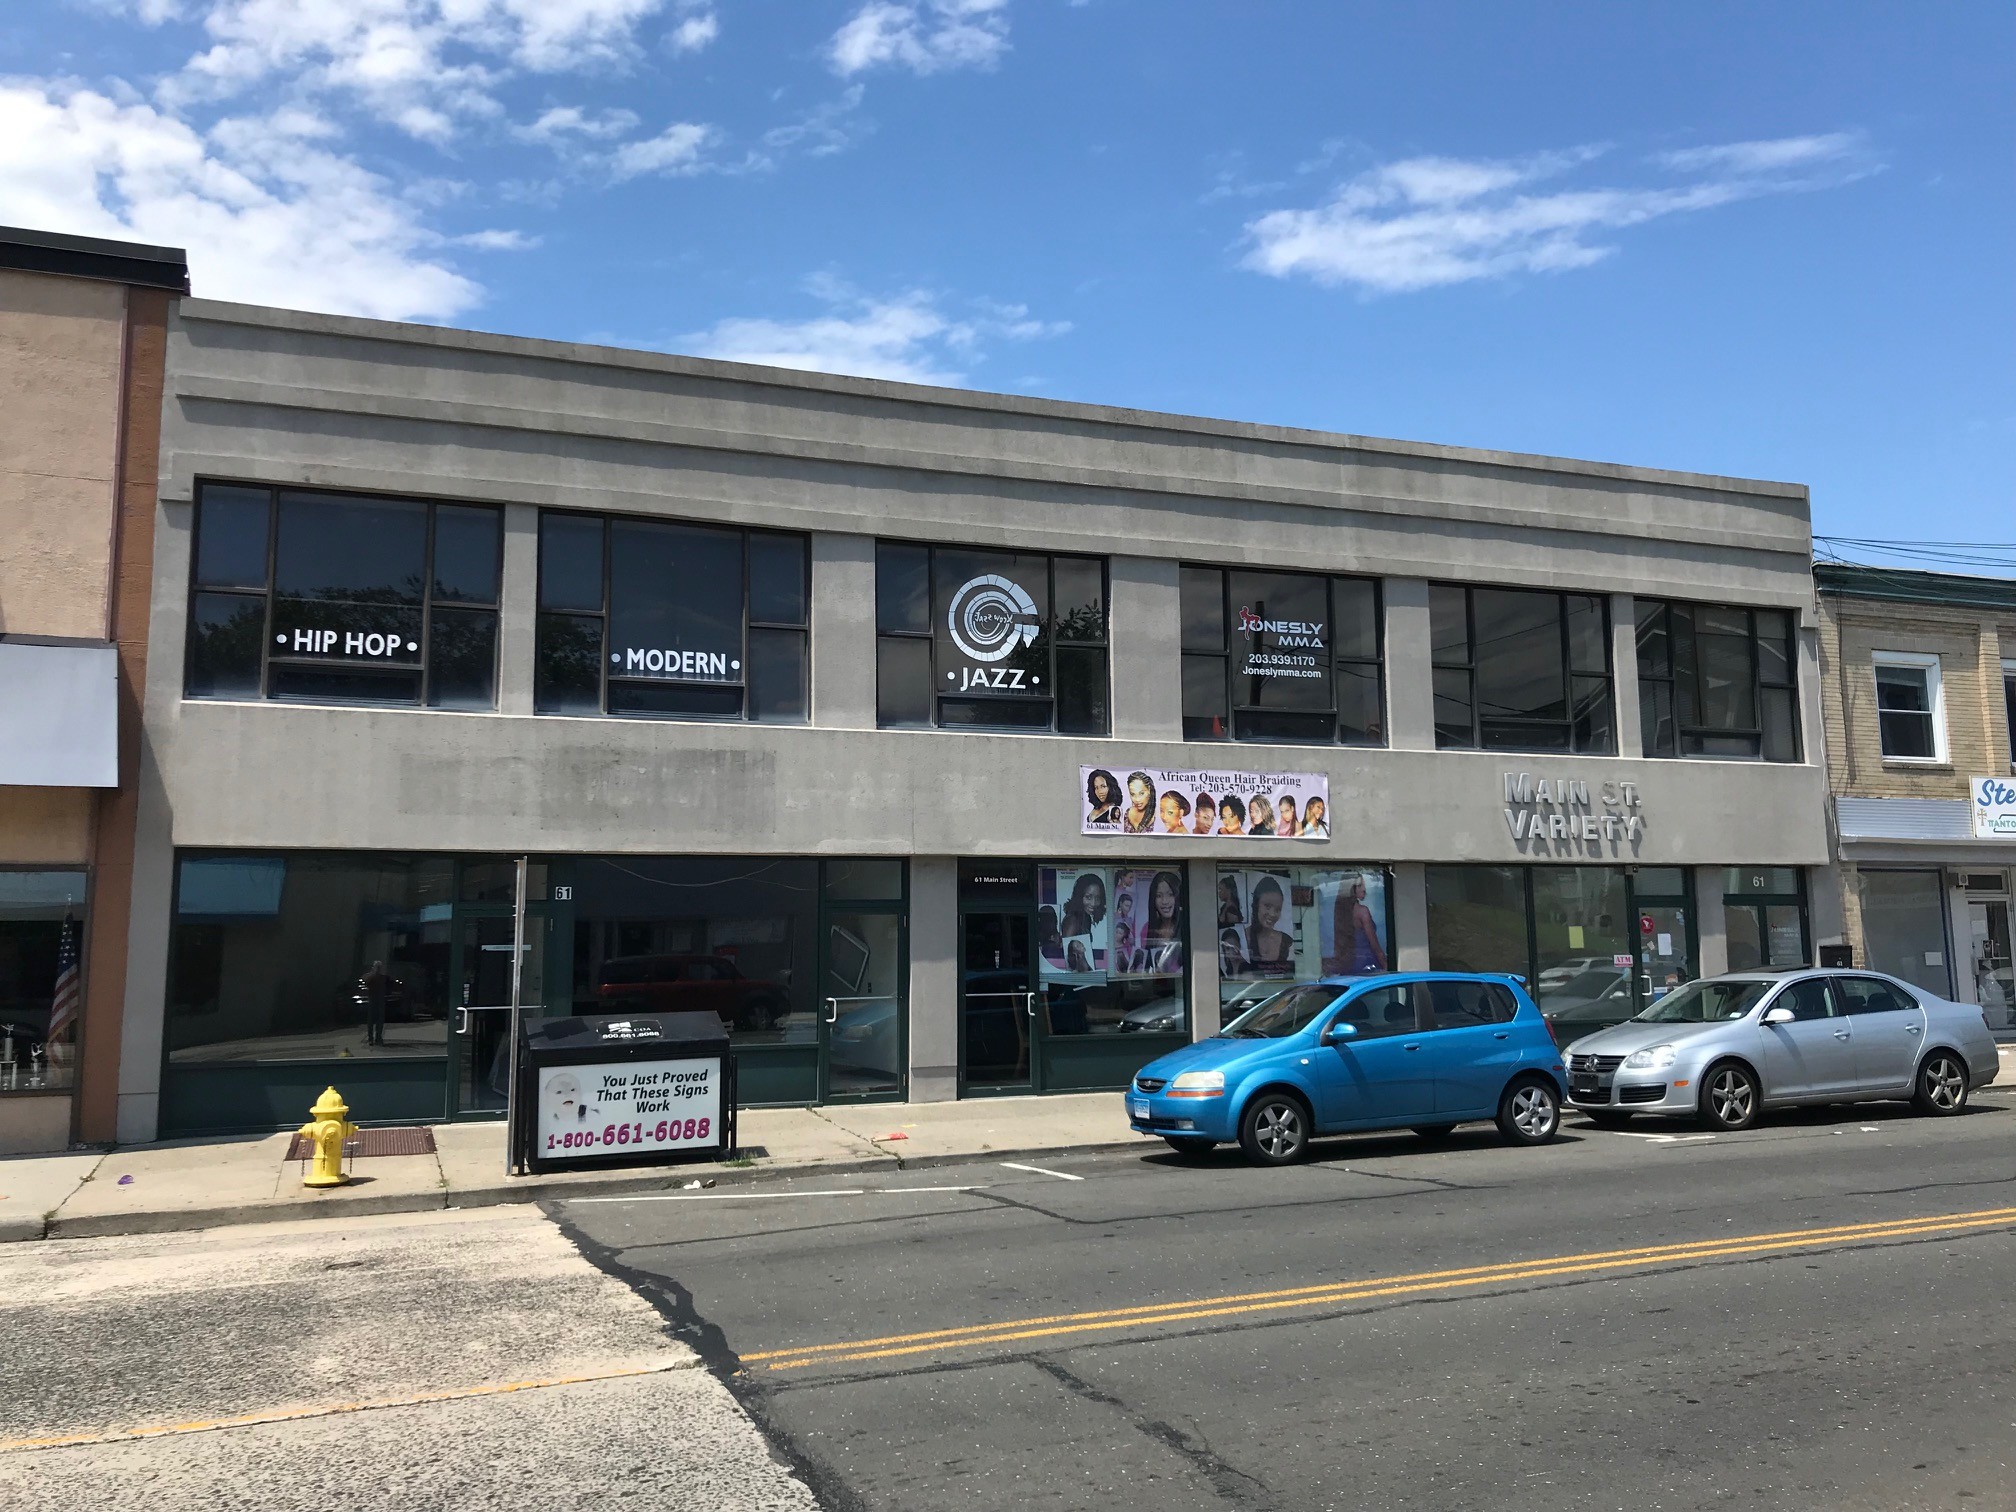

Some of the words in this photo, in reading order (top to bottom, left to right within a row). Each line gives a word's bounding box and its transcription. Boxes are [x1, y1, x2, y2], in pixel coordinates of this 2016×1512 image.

[1237, 619, 1323, 635] JONESLY
[294, 628, 338, 653] HIP
[345, 631, 401, 657] HOP
[1278, 635, 1324, 648] MMA
[627, 647, 726, 675] MODERN
[1248, 653, 1315, 667] 203.939.1170
[960, 666, 1027, 692] JAZZ
[1242, 665, 1322, 678] Joneslymma.com
[1159, 771, 1196, 783] African
[1199, 772, 1231, 784] Queen
[1233, 773, 1257, 785] Hair
[1259, 774, 1302, 788] Braiding
[1189, 783, 1206, 793] Tel:
[1208, 782, 1273, 795] 203-570-9228
[1504, 772, 1588, 805] MAIN
[1095, 822, 1111, 830] Main
[1504, 808, 1638, 841] VARIETY
[1752, 876, 1765, 887] 61
[557, 887, 570, 899] 61
[603, 1074, 627, 1087] You
[630, 1072, 657, 1086] Just
[662, 1069, 709, 1084] Proved
[597, 1088, 627, 1102] That
[632, 1086, 669, 1100] These
[674, 1084, 709, 1099] Signs
[636, 1100, 670, 1114] Work
[547, 1117, 711, 1150] 1-800-661-6088
